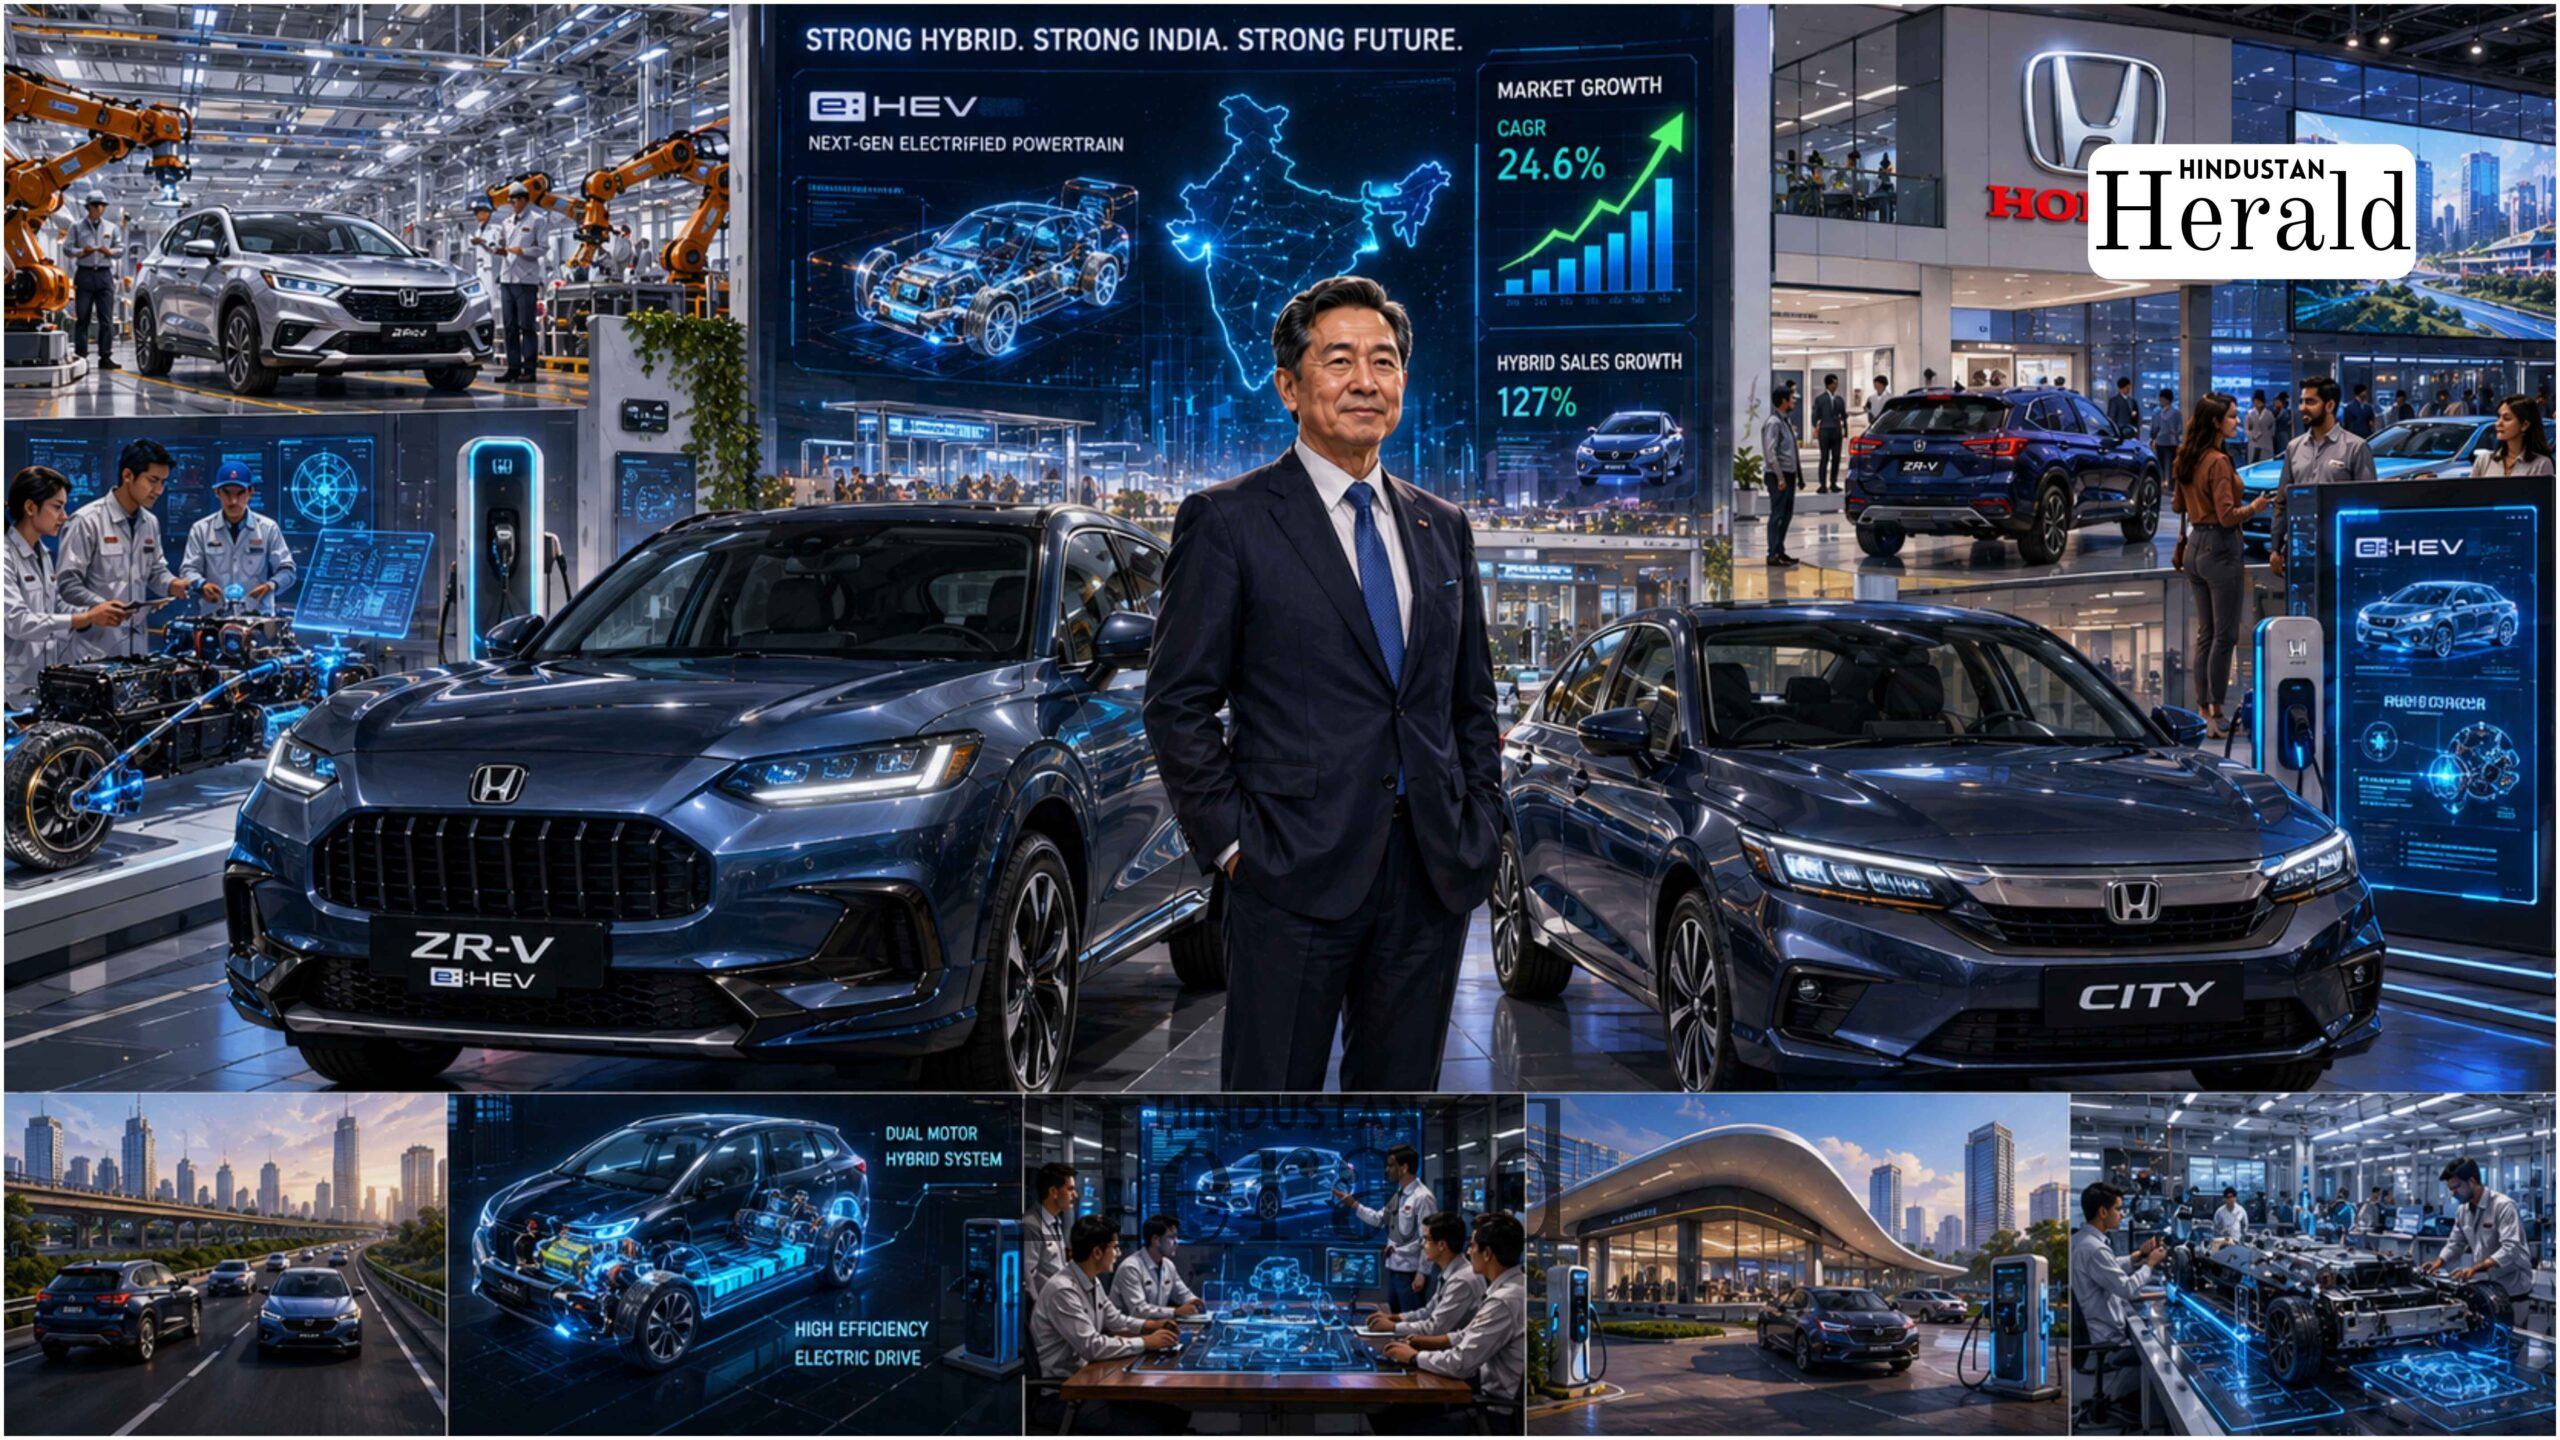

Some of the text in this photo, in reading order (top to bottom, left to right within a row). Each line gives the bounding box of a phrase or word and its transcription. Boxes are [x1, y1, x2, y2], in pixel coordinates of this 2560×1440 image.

[806, 27, 1463, 52] STRONG HYBRID. STRONG INDIA. STRONG FUTURE.
[1497, 76, 1662, 99] MARKET GROWTH
[1497, 119, 1546, 137] CAGR
[808, 135, 894, 152] NEXT-GEN
[1012, 137, 1124, 152] POWERTRAIN
[1497, 146, 1606, 181] 24.6%
[1497, 352, 1683, 372] HYBRID SALES GROWTH
[1497, 386, 1577, 418] 127%
[411, 931, 555, 964] ZR-V
[2079, 981, 2216, 1010] CITY
[885, 1125, 978, 1142] DUAL MOTOR
[885, 1151, 1003, 1167] HYBRID SYSTEM
[794, 1320, 930, 1338] HIGH EFFICIENCY
[794, 1349, 921, 1367] ELECTRIC DRIVE
